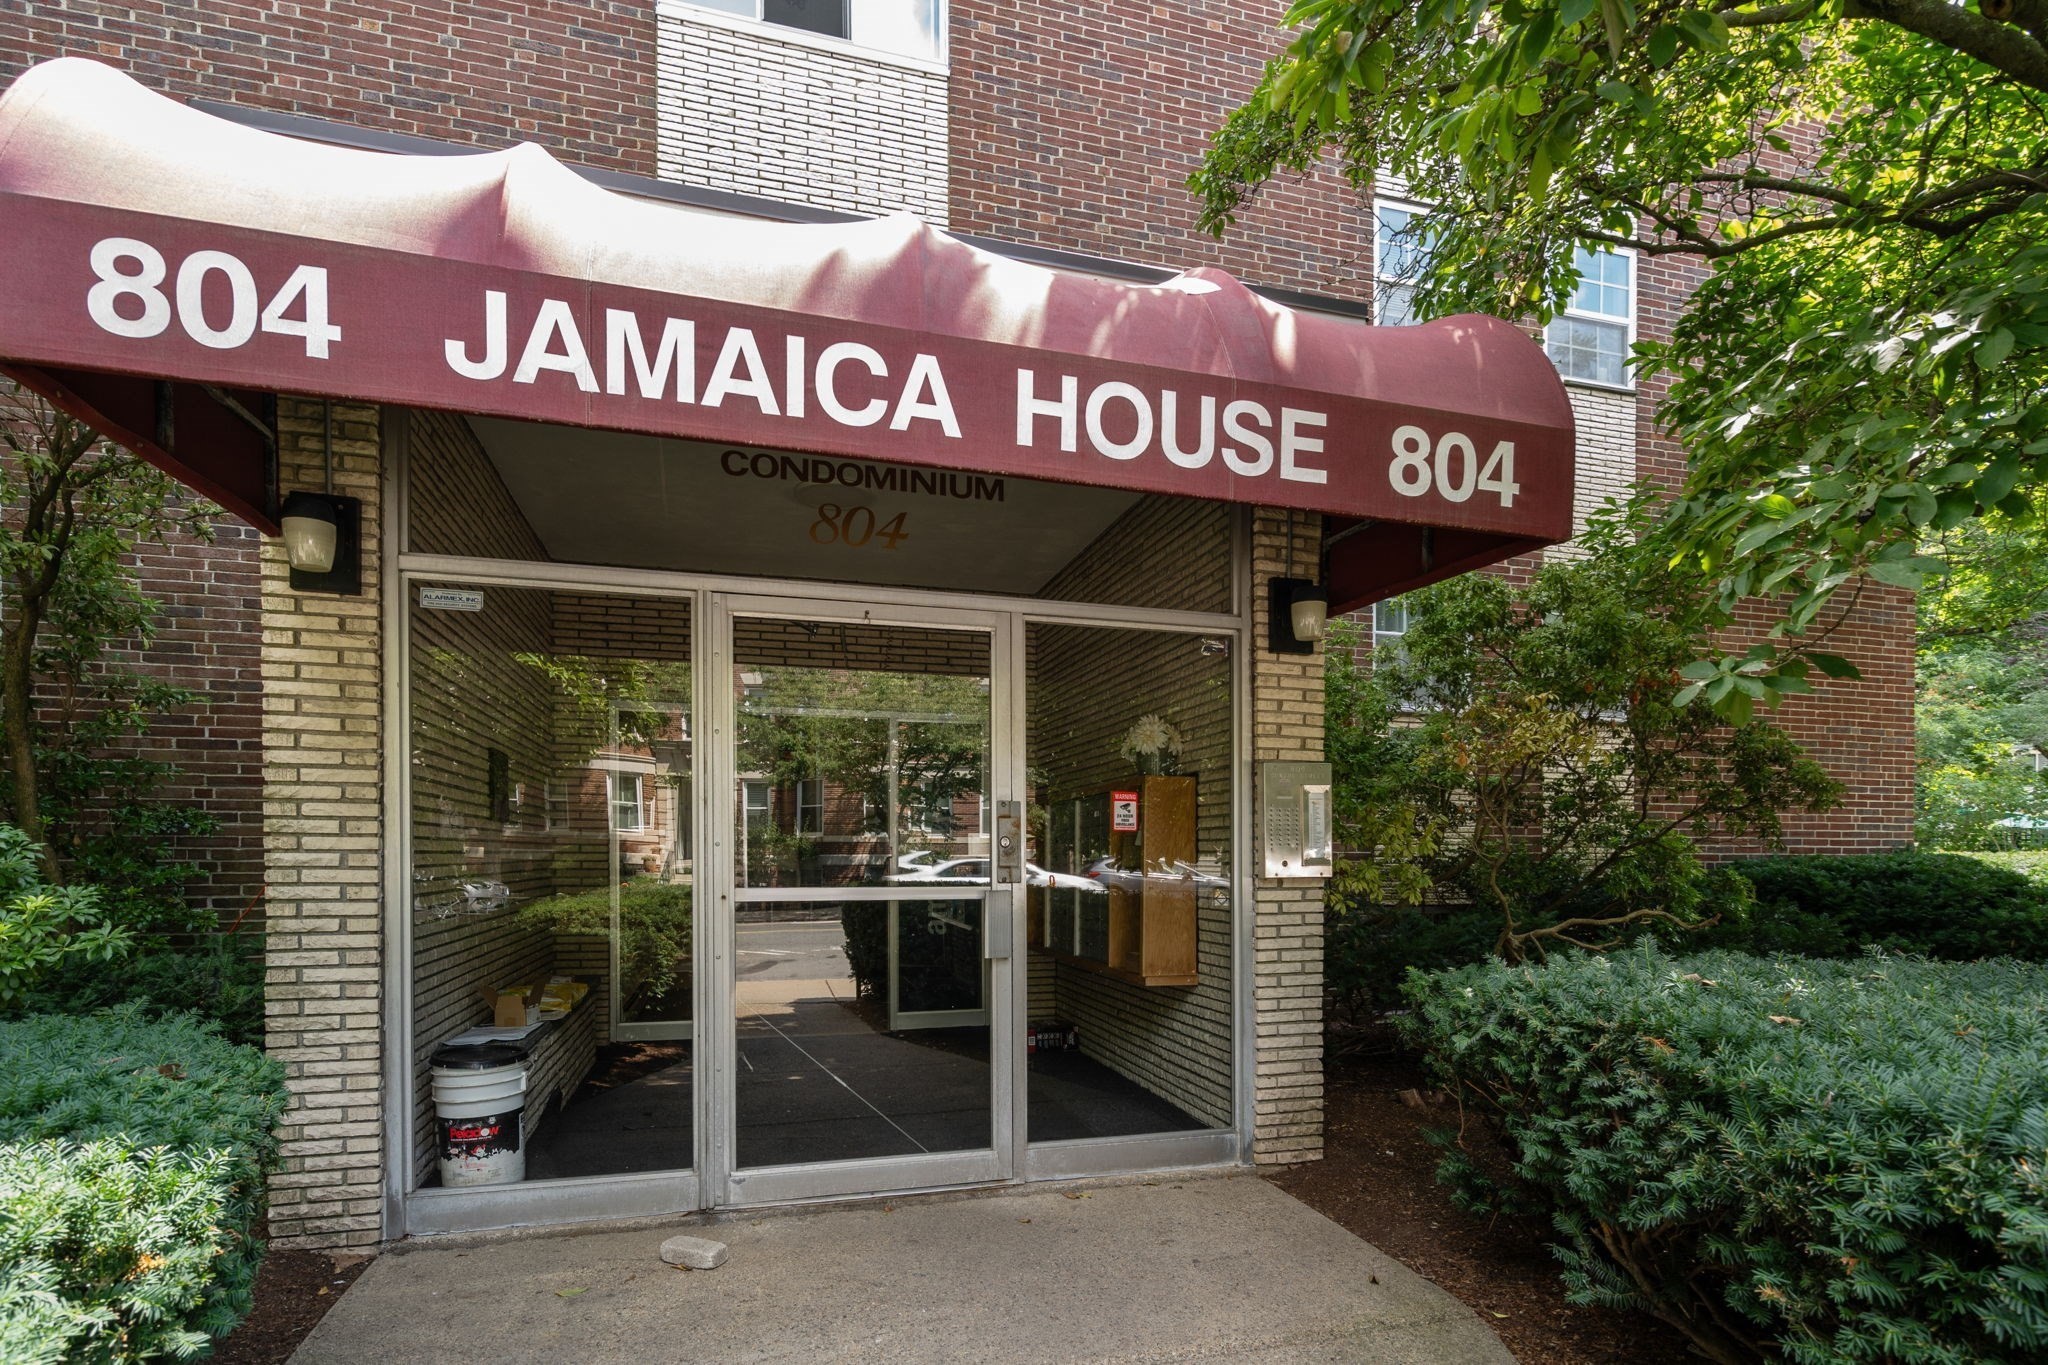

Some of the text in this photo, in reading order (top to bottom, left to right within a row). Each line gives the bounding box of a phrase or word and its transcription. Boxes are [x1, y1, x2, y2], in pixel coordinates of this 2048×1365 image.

[86, 237, 1521, 508] 804 JAMAICA HOUSE 804
[720, 449, 1005, 502] CONDOMINIUM
[809, 502, 910, 550] 804
